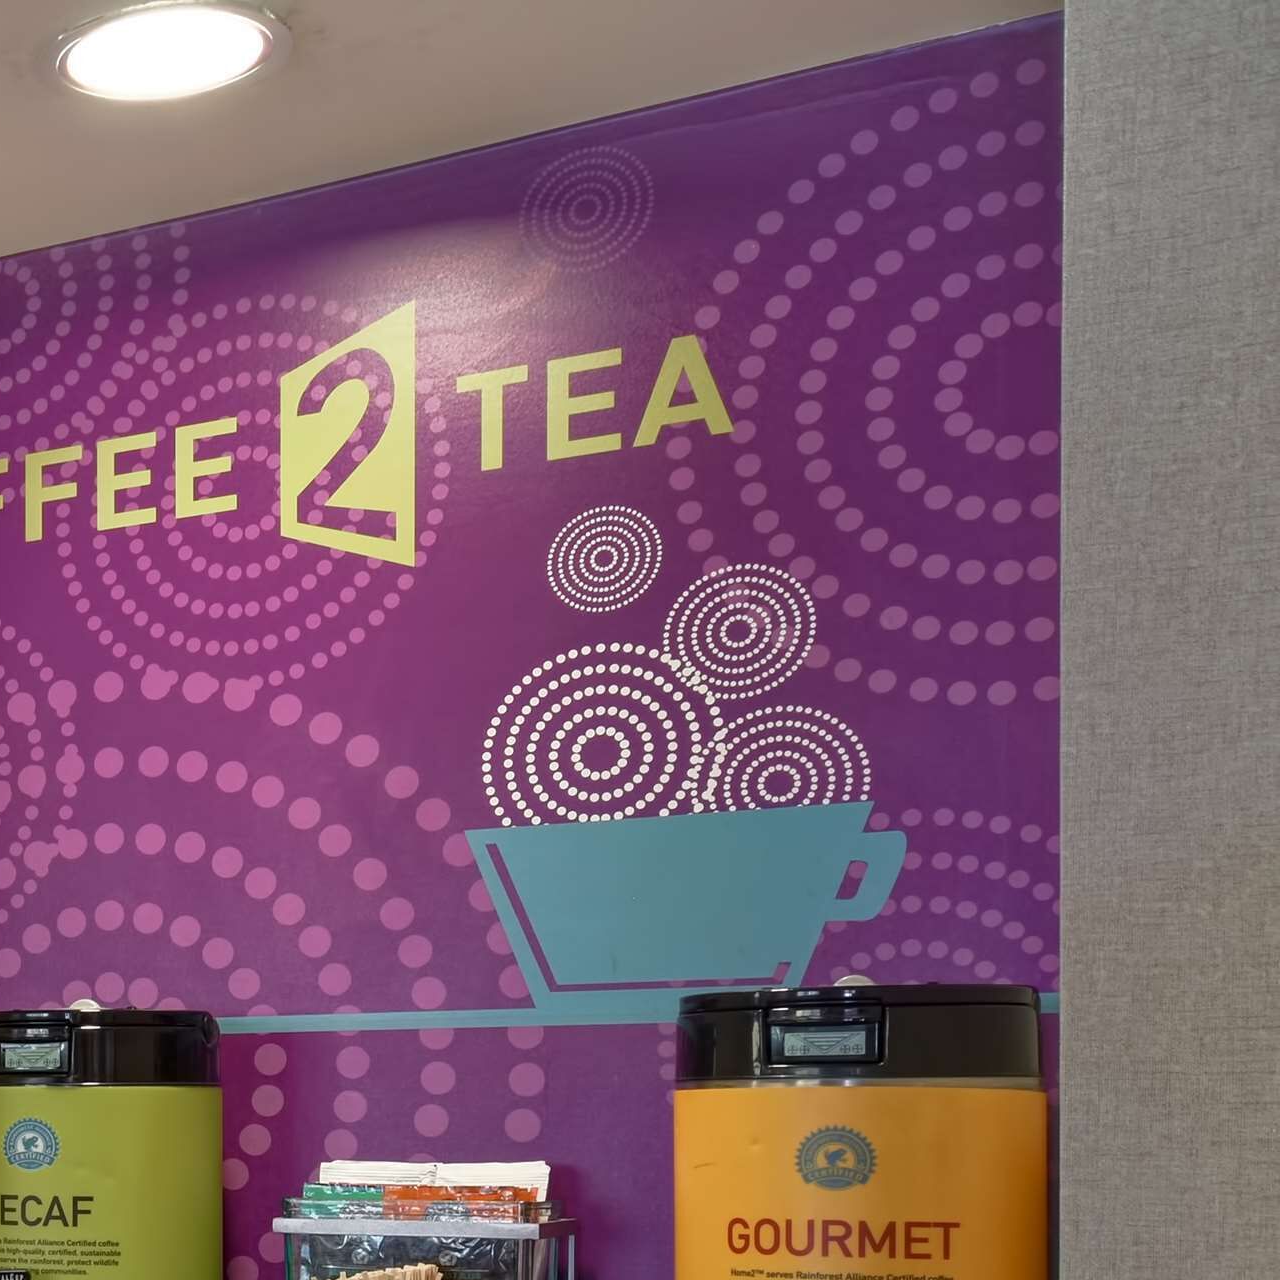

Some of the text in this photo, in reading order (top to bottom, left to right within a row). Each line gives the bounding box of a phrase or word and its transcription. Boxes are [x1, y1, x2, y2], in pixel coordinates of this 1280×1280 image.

[281, 300, 415, 567] 2
[457, 335, 733, 471] TEA
[726, 1216, 961, 1261] GOURMET
[37, 1239, 66, 1247] Alliance
[66, 1239, 97, 1248] Certified
[98, 1240, 120, 1248] coffee
[66, 1259, 92, 1267] protect
[766, 1271, 794, 1279] serves
[796, 1271, 843, 1280] Rainforest
